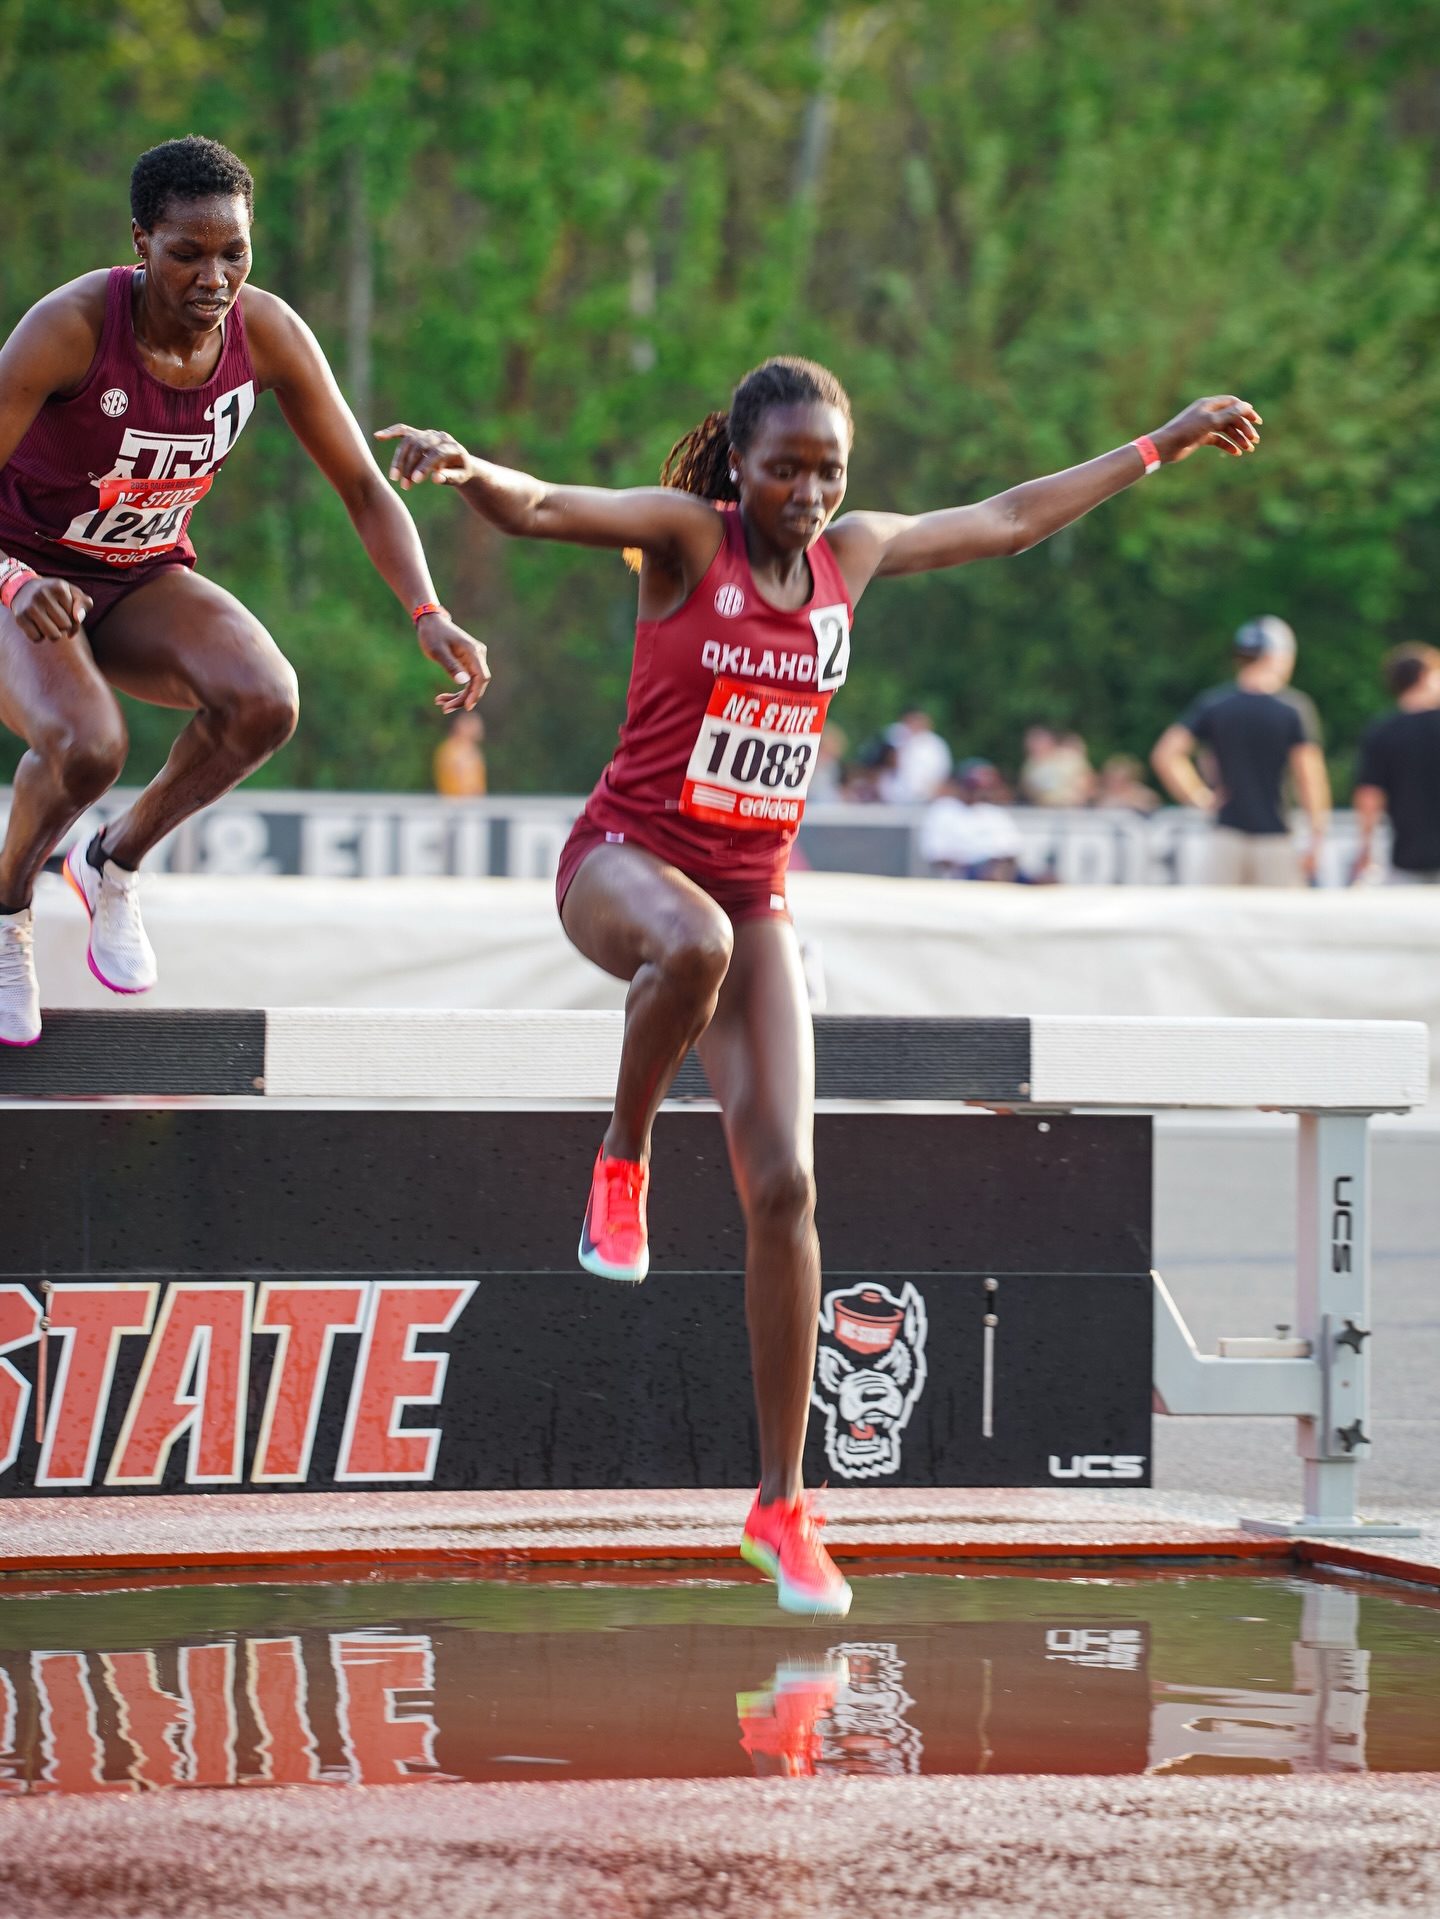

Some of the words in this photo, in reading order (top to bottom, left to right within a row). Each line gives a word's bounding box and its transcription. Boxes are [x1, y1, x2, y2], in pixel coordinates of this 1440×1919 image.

[102, 390, 126, 416] SEC
[221, 393, 240, 450] 1
[141, 485, 204, 508] STATE
[81, 504, 183, 546] 1244
[701, 639, 819, 683] OKLAHO
[819, 616, 843, 680] 2
[722, 692, 761, 727] NC
[759, 702, 819, 735] STATE
[706, 728, 812, 789] 1083
[738, 796, 799, 822] adidas
[1332, 1175, 1353, 1273] UCS
[1047, 1454, 1147, 1479] UCS
